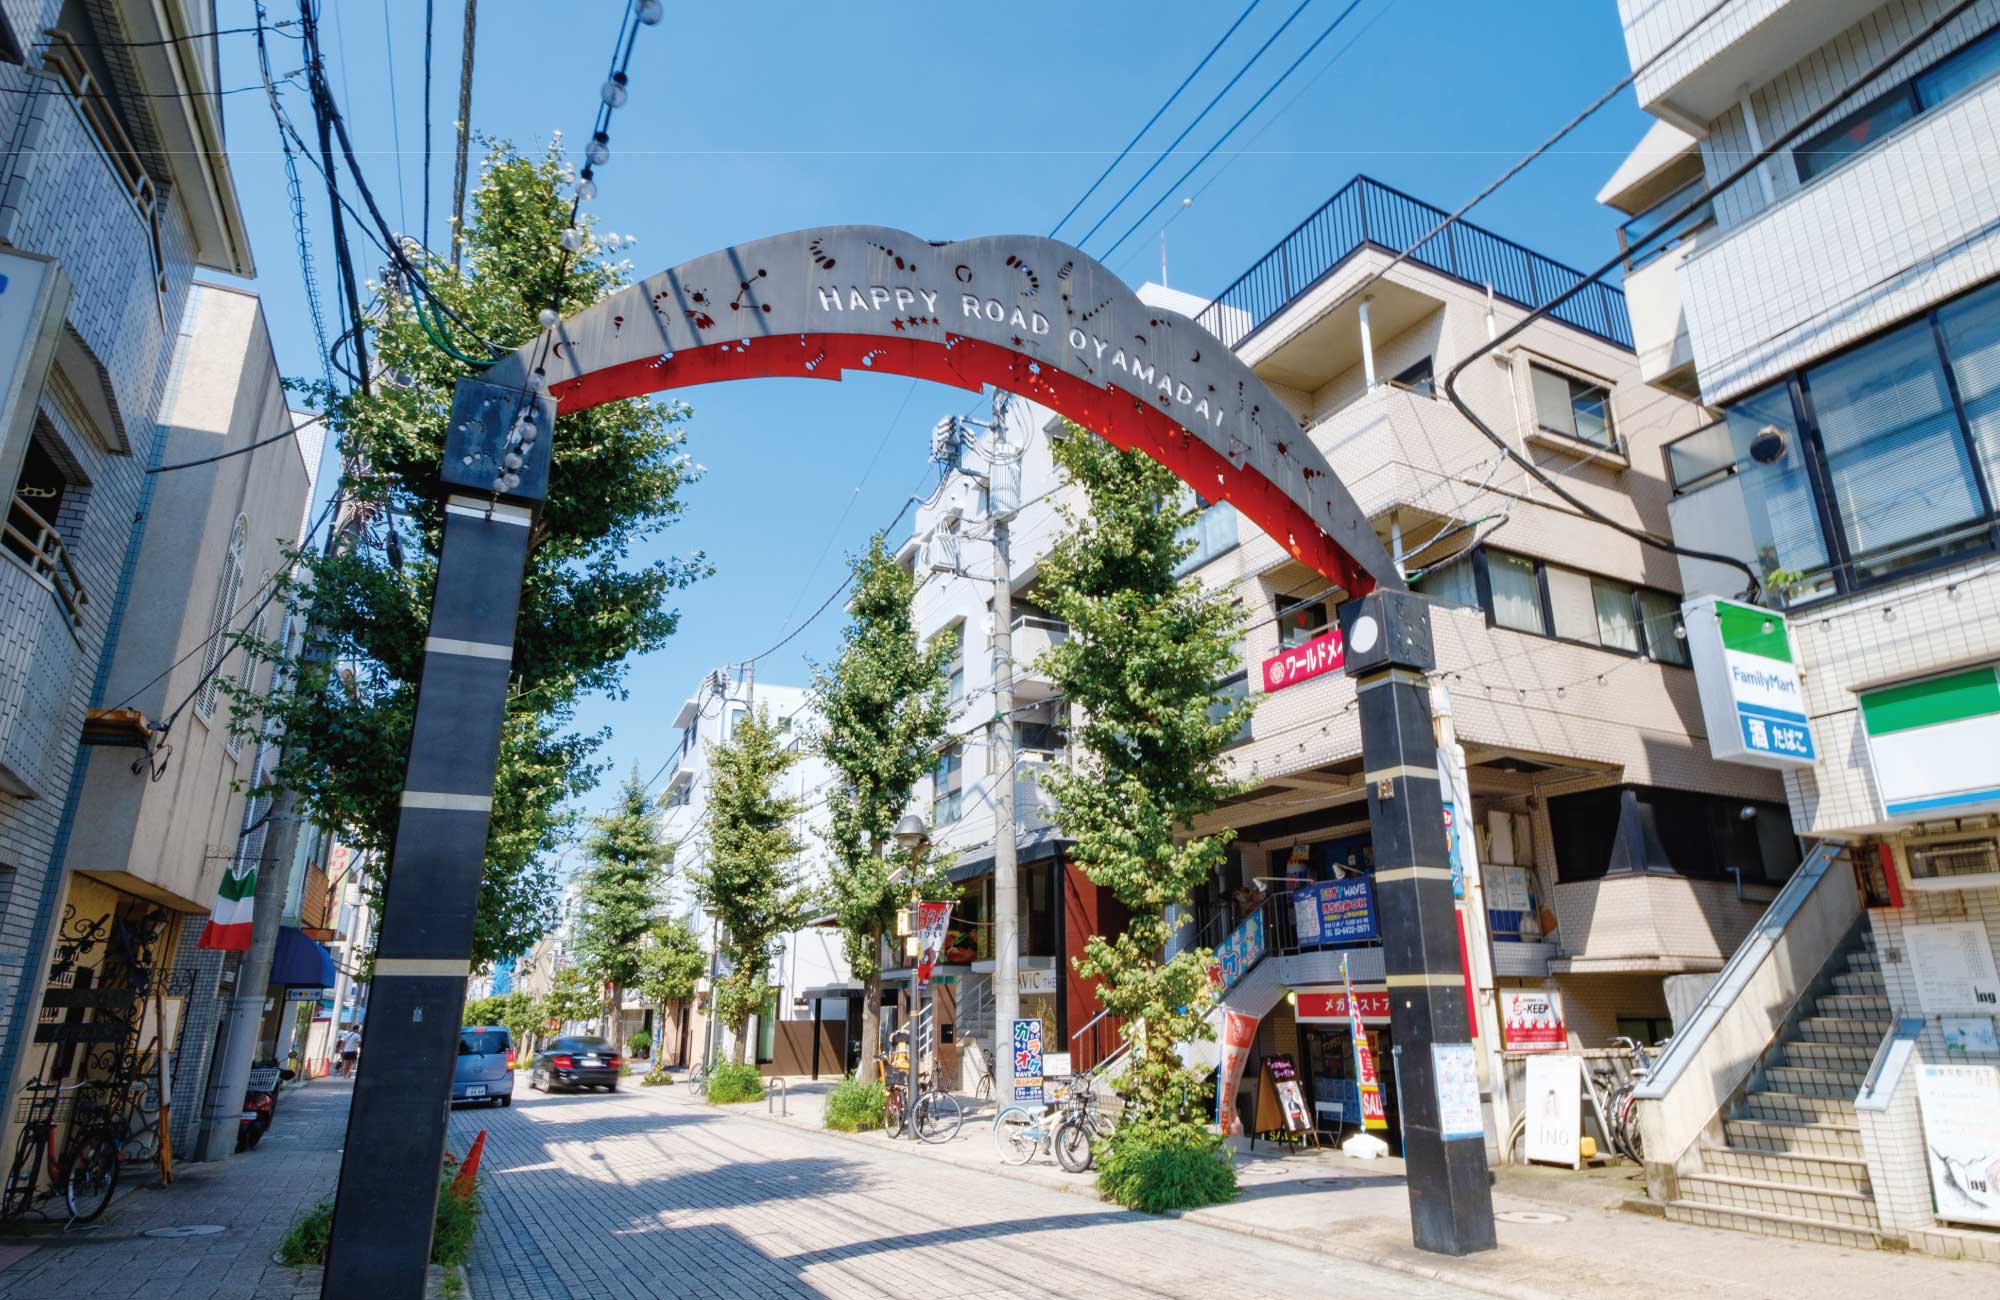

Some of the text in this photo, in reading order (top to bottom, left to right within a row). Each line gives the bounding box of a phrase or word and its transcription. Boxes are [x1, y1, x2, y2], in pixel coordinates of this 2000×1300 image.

[817, 285, 1224, 427] HAPPY ROAD OYAMADAI
[1732, 665, 1796, 694] FamilyMart
[1748, 718, 1808, 753] 酒 たばこ
[1343, 883, 1367, 897] WAVE
[1325, 998, 1391, 1011] メガストア
